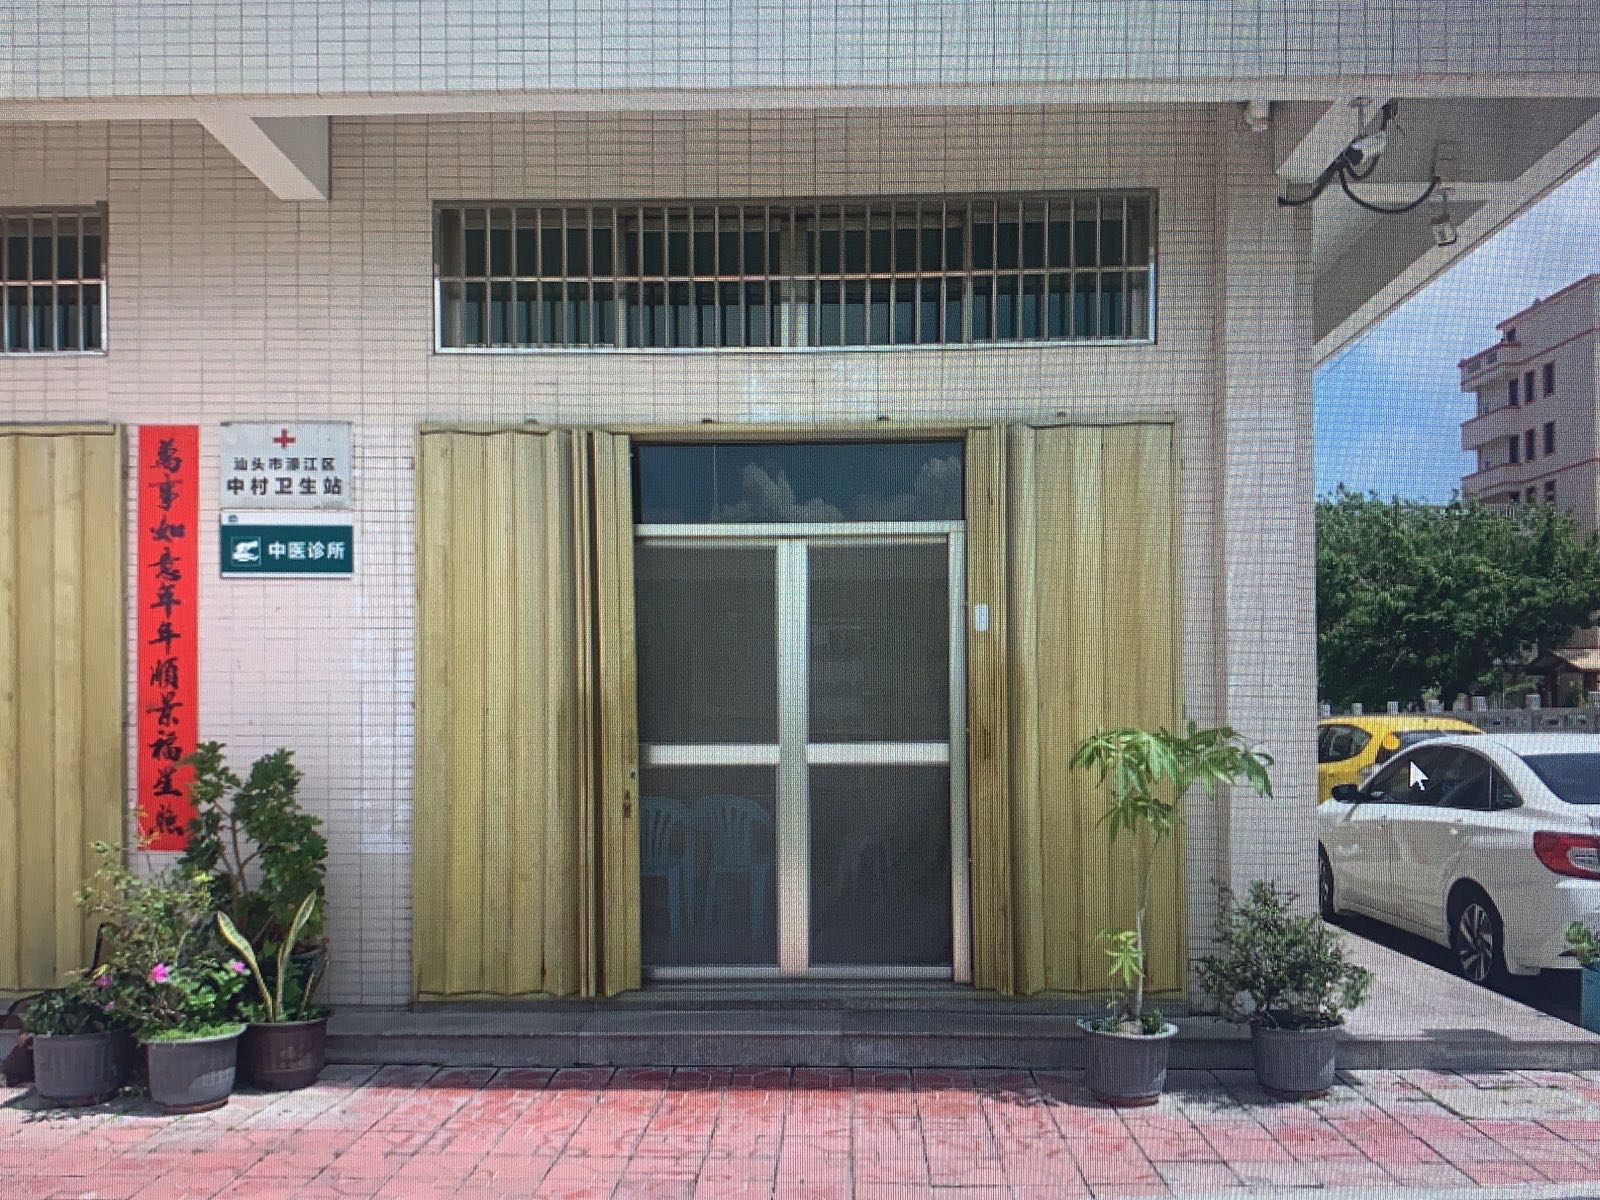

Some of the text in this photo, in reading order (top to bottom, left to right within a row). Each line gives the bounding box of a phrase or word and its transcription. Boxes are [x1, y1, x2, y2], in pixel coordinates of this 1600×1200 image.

[227, 476, 342, 495] 中村卫生站
[268, 541, 345, 560] 中医诊所
